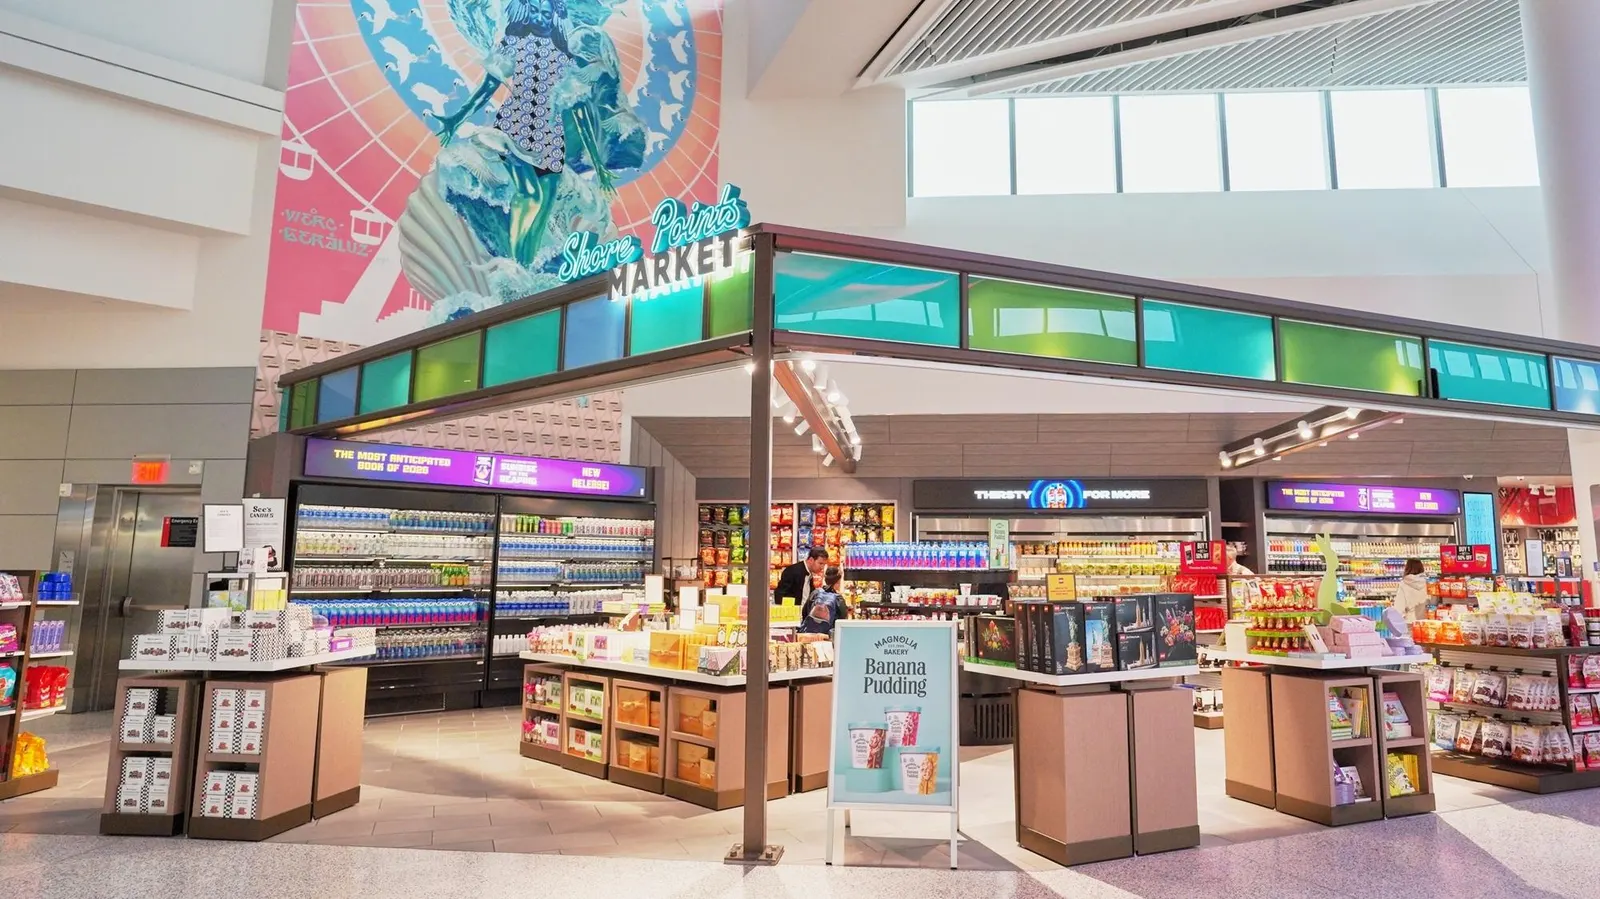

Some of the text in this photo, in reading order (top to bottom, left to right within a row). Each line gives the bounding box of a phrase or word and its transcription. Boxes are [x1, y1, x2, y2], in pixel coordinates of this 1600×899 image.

[558, 183, 744, 282] Shore Points
[608, 230, 739, 301] MARKET
[334, 449, 451, 466] THE MOST ANTICIPATED
[357, 461, 384, 471] BOOK
[387, 463, 400, 472] OF
[582, 467, 600, 478] NEW
[974, 490, 1150, 500] THIRSTY FOR MORE
[874, 635, 918, 650] MAGNOLIA
[865, 658, 926, 675] Banana
[864, 677, 927, 698] Pudding
